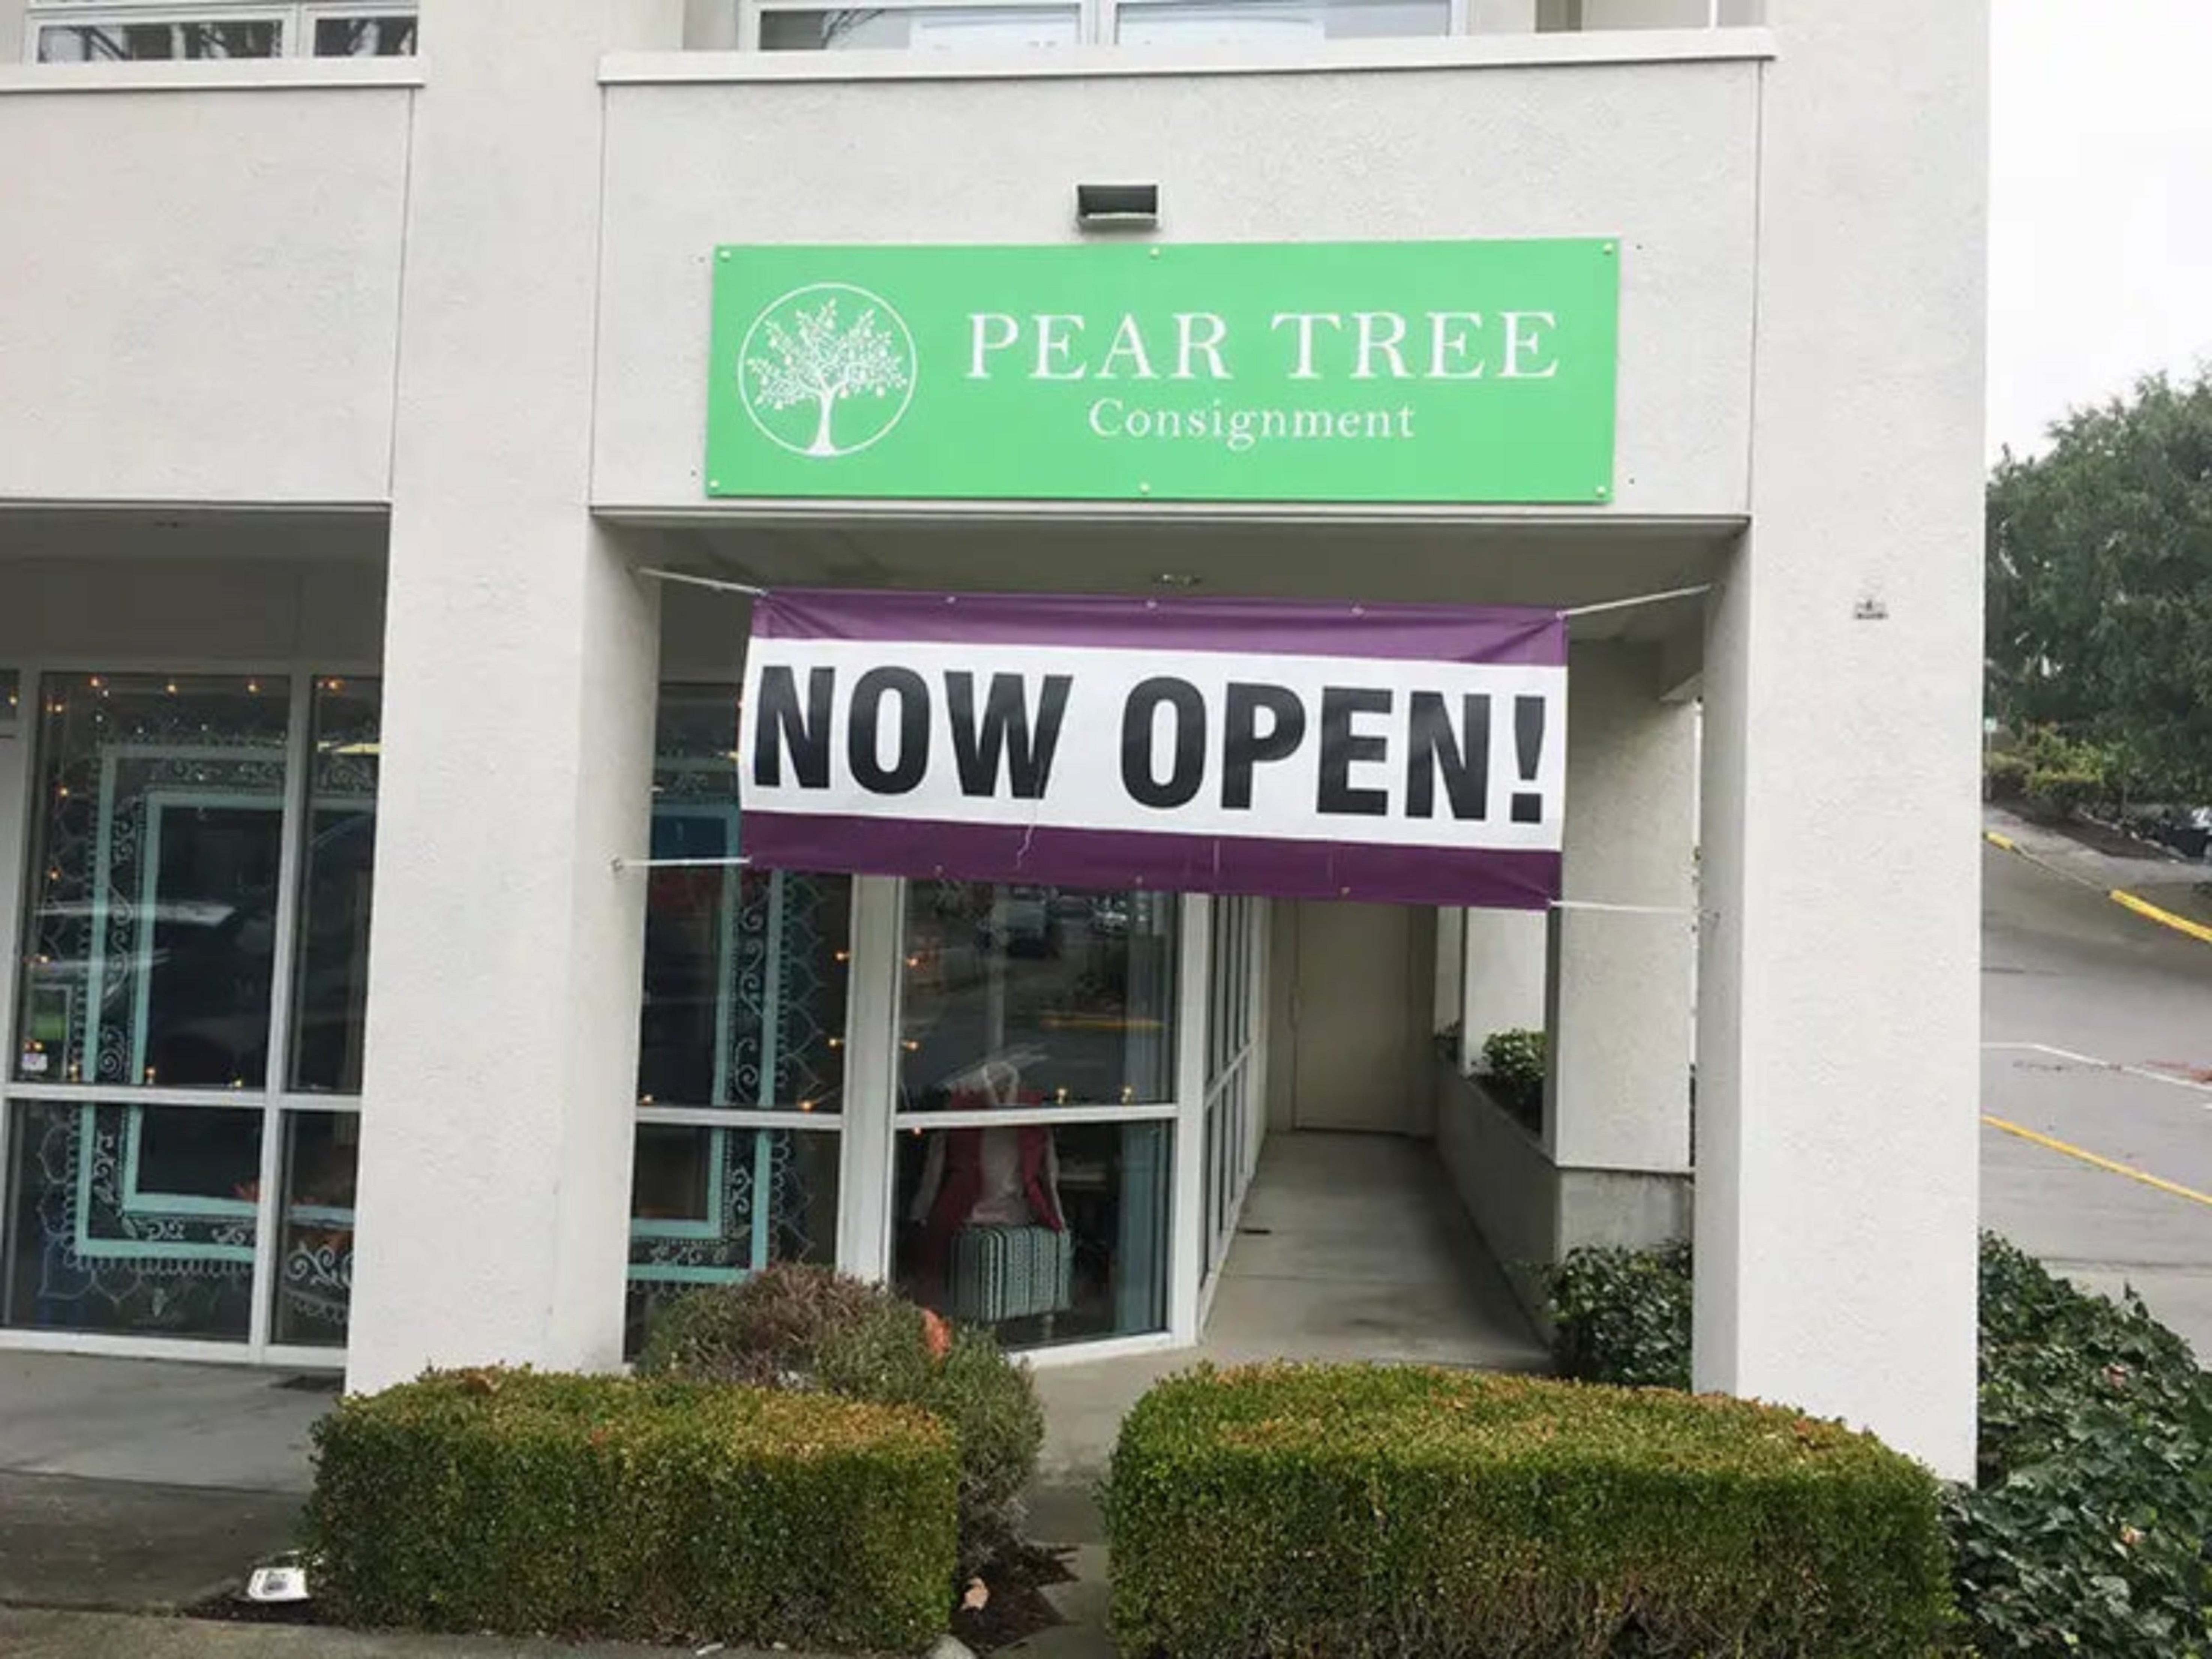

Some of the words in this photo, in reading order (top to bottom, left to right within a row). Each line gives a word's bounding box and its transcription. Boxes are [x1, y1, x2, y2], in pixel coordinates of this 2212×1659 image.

[967, 312, 1231, 380] PEAR
[1270, 310, 1559, 380] TREE
[1089, 397, 1414, 450] Consignment
[753, 665, 1073, 800] NOW
[1121, 677, 1545, 824] OPEN!
